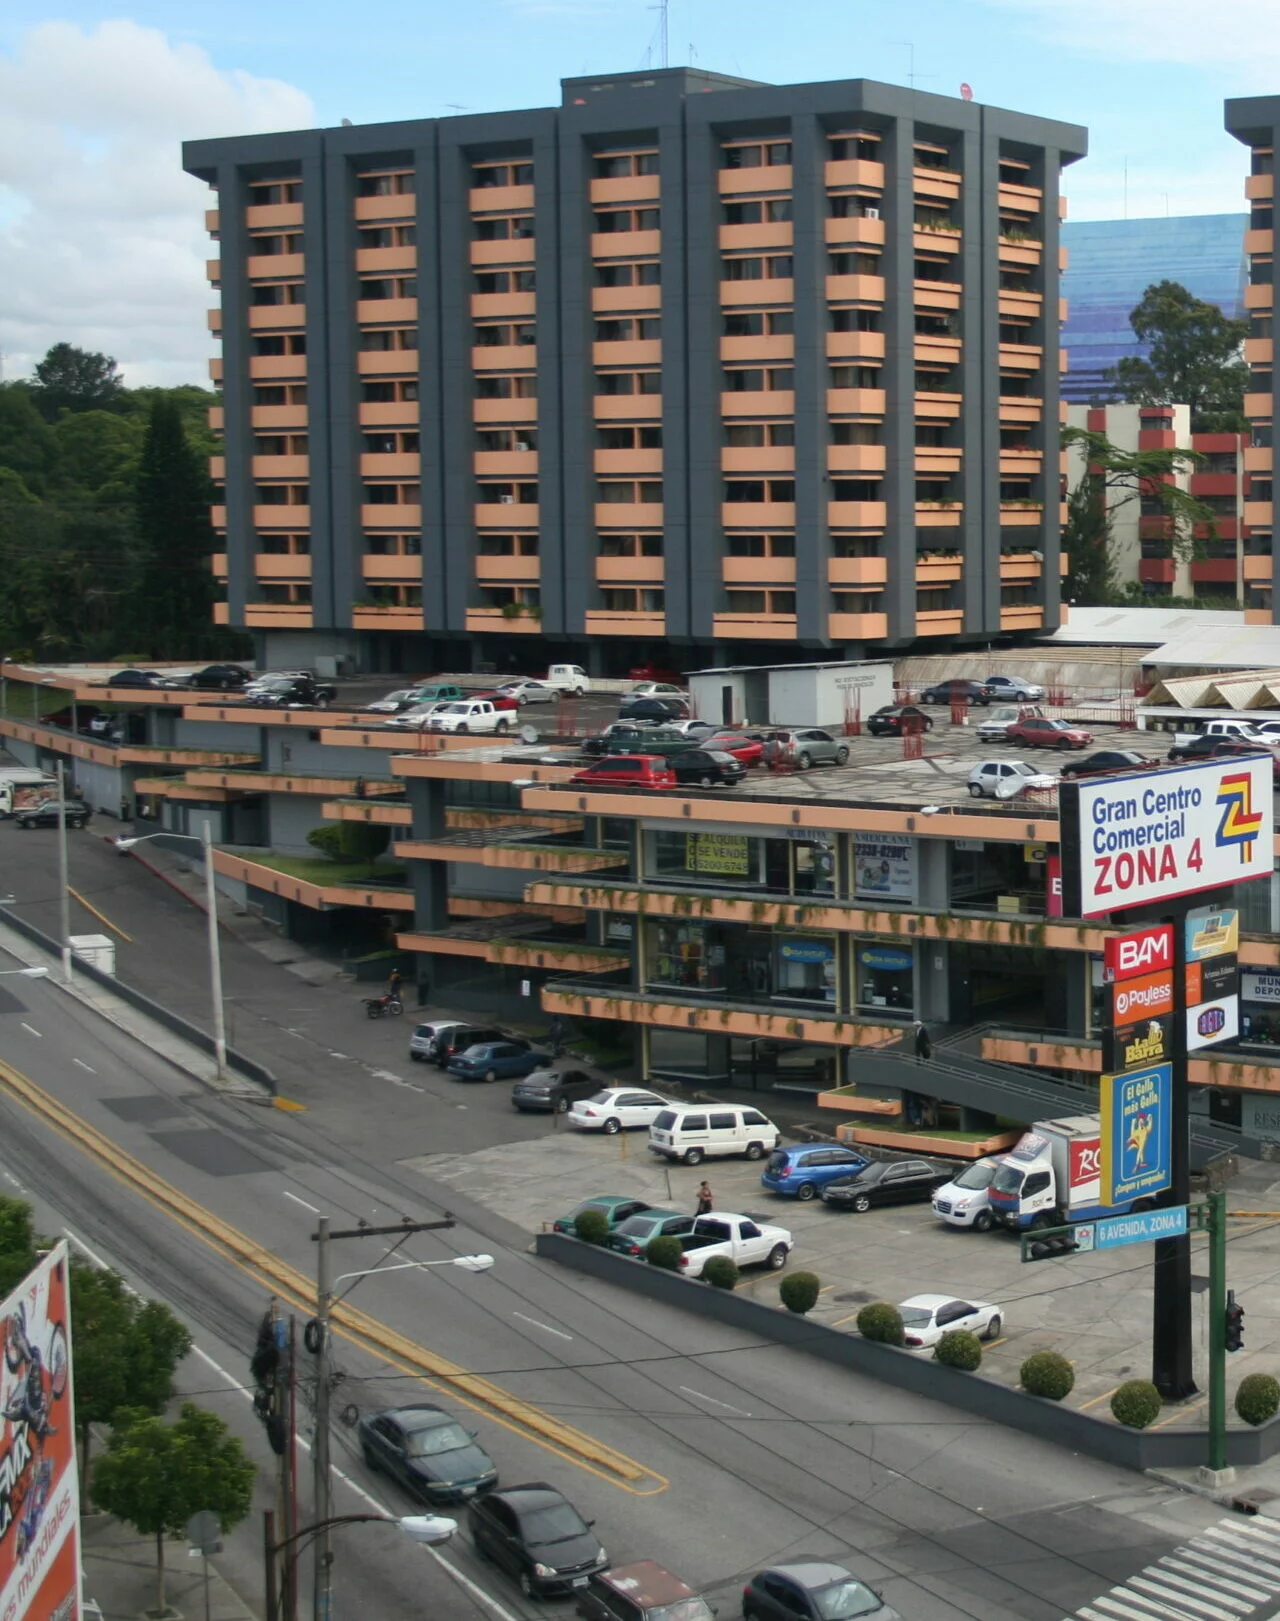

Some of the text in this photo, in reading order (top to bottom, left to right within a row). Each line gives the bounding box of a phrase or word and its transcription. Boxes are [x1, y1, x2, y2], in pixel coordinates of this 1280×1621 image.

[1092, 785, 1201, 824] Gran Centro
[1093, 812, 1185, 854] Comercial
[698, 846, 711, 857] SE
[713, 847, 748, 860] VENDE
[1094, 837, 1203, 895] ZONA 4
[1120, 933, 1168, 970] BAM
[1129, 984, 1171, 1006] Payless
[1125, 1042, 1164, 1063] Barra
[1127, 1078, 1154, 1101] El Gallo
[1140, 1090, 1158, 1109] Gallo
[1100, 1213, 1182, 1240] 6 AVENIDA, ZONA 4
